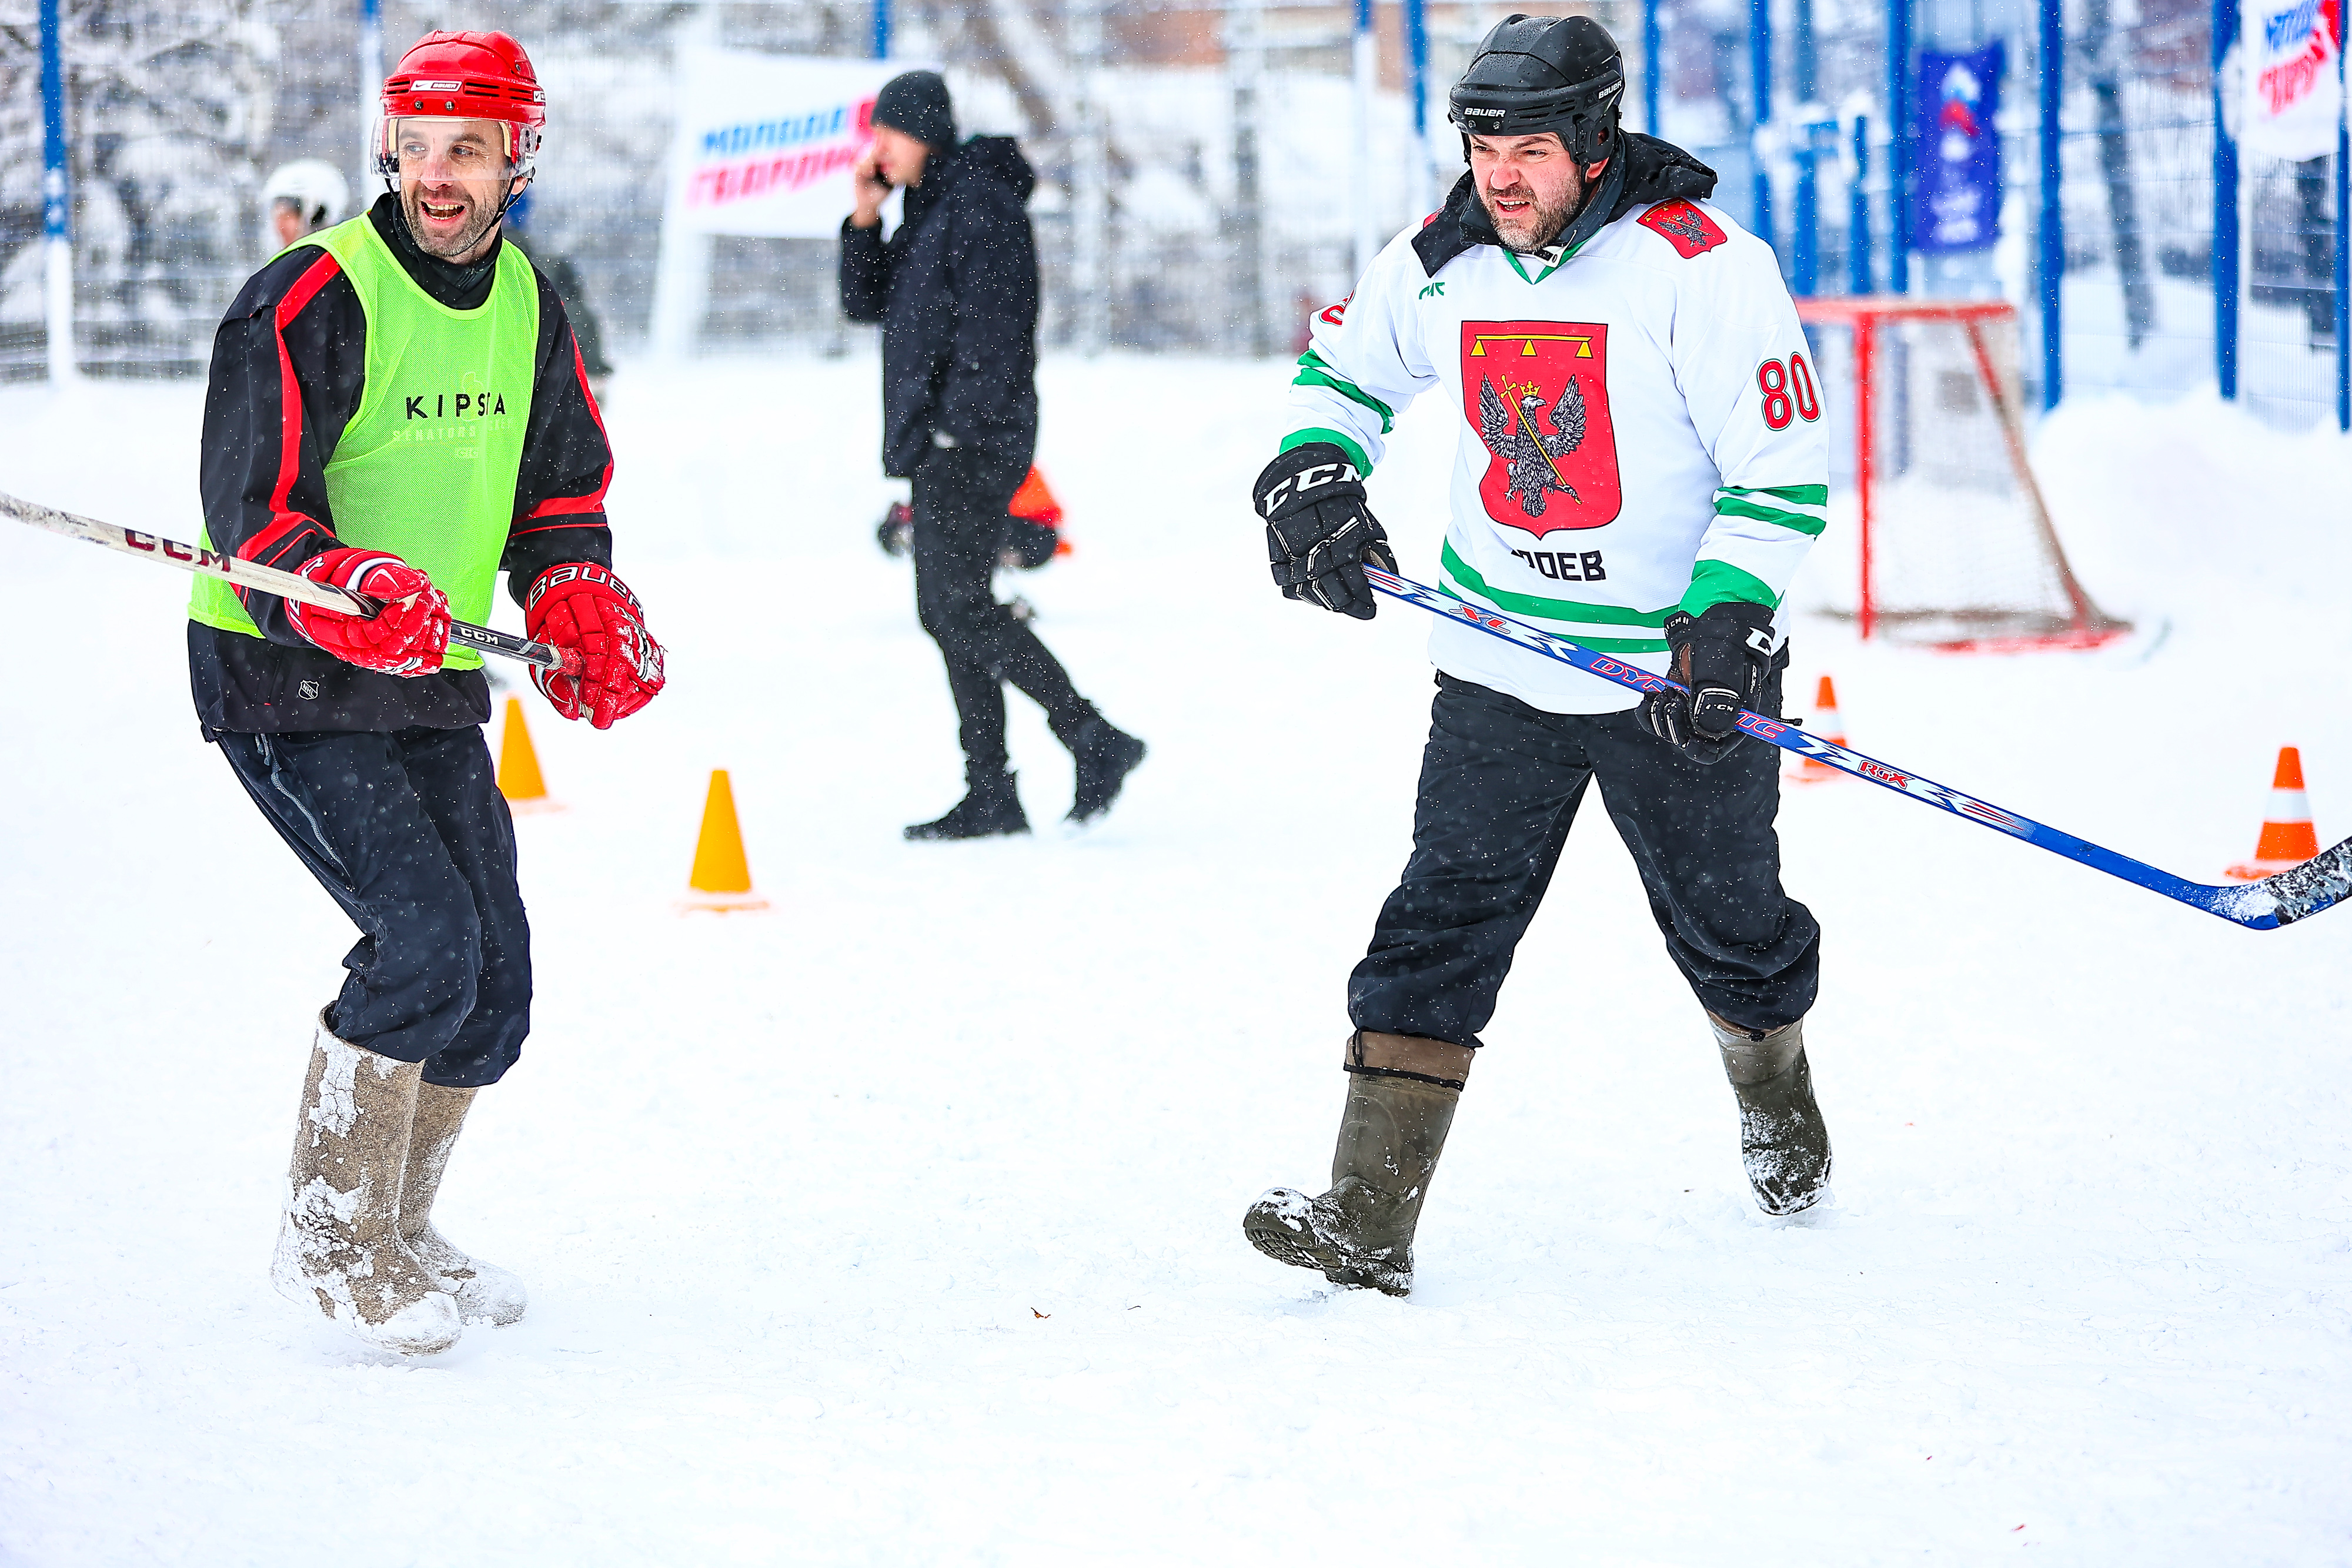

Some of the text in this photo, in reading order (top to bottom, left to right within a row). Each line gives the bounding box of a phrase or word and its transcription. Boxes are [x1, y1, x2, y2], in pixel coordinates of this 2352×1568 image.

[1464, 107, 1506, 118] BAUER
[1756, 351, 1821, 432] 80
[125, 529, 231, 573] CCM
[1449, 605, 1511, 634] XL
[458, 627, 499, 646] CCM
[302, 683, 315, 698] NHL
